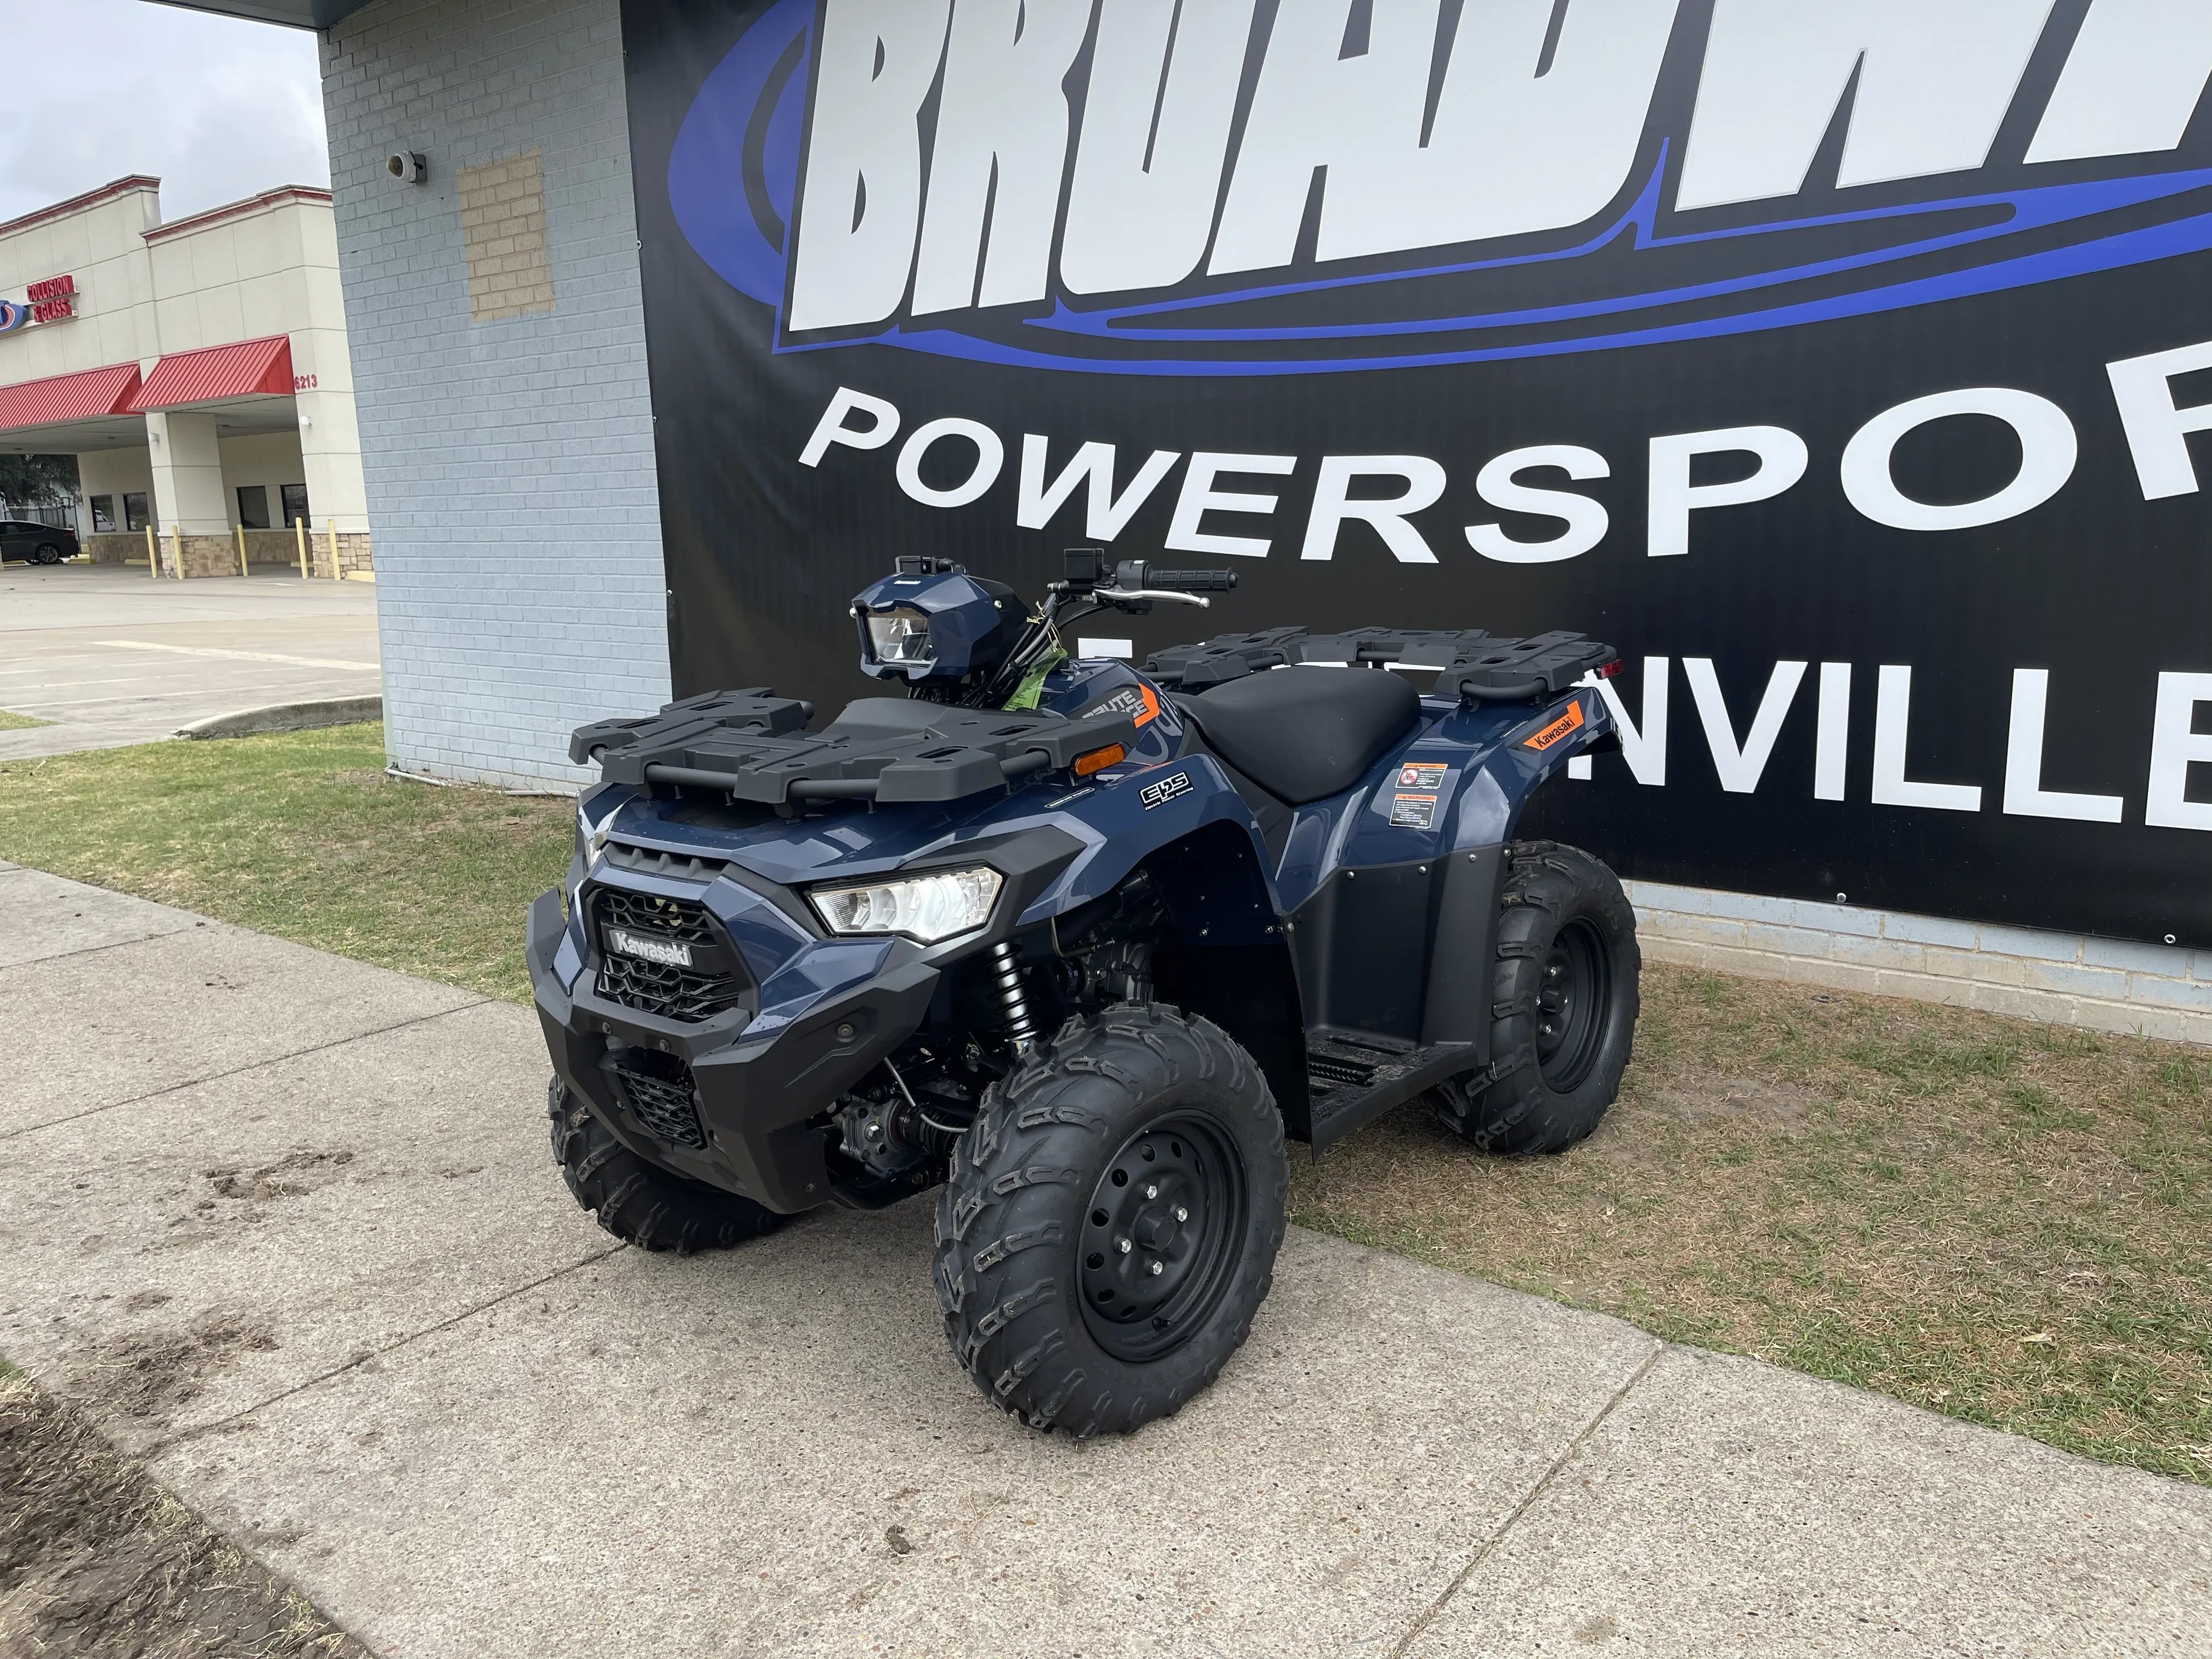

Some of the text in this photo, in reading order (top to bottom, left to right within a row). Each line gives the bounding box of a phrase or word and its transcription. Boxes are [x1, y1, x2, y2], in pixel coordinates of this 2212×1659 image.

[27, 275, 72, 302] COLLISION
[34, 298, 70, 323] & GLASS
[295, 374, 318, 390] 6213
[1534, 716, 1575, 747] Kawasaki
[1141, 772, 1188, 803] EPS
[614, 932, 690, 967] Kawasaki
